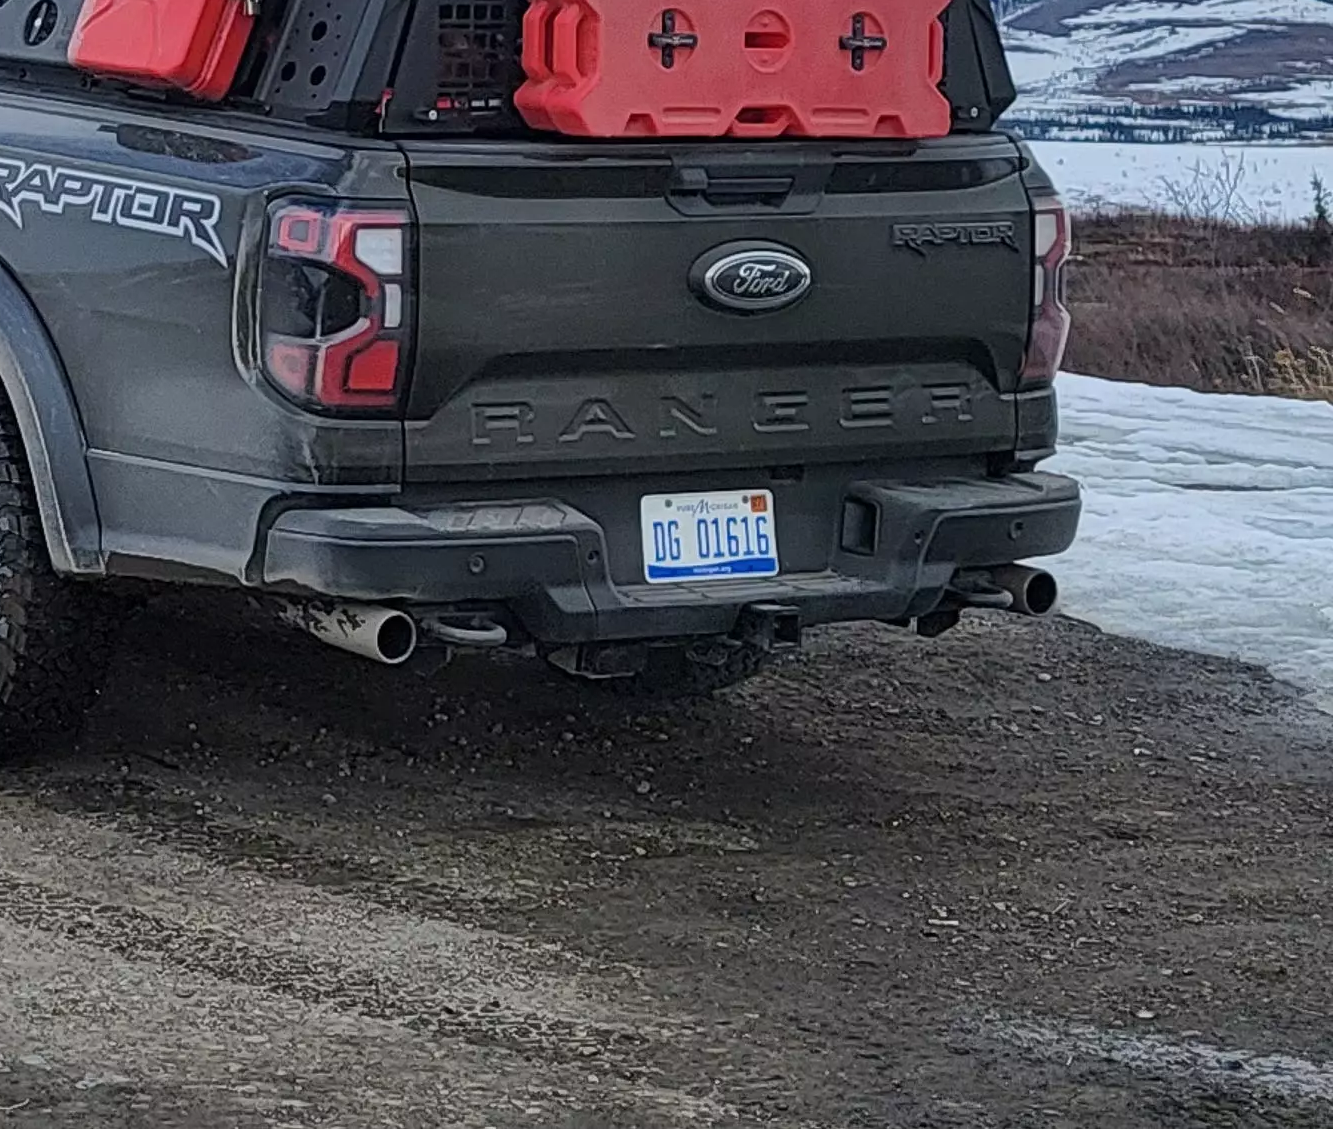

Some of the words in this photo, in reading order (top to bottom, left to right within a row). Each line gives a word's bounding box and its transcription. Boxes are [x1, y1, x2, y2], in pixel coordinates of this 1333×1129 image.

[891, 221, 1020, 258] RAPTOR
[733, 262, 790, 294] Ford
[470, 381, 974, 445] RANGER
[652, 520, 681, 562] DG
[696, 515, 770, 560] 01616
